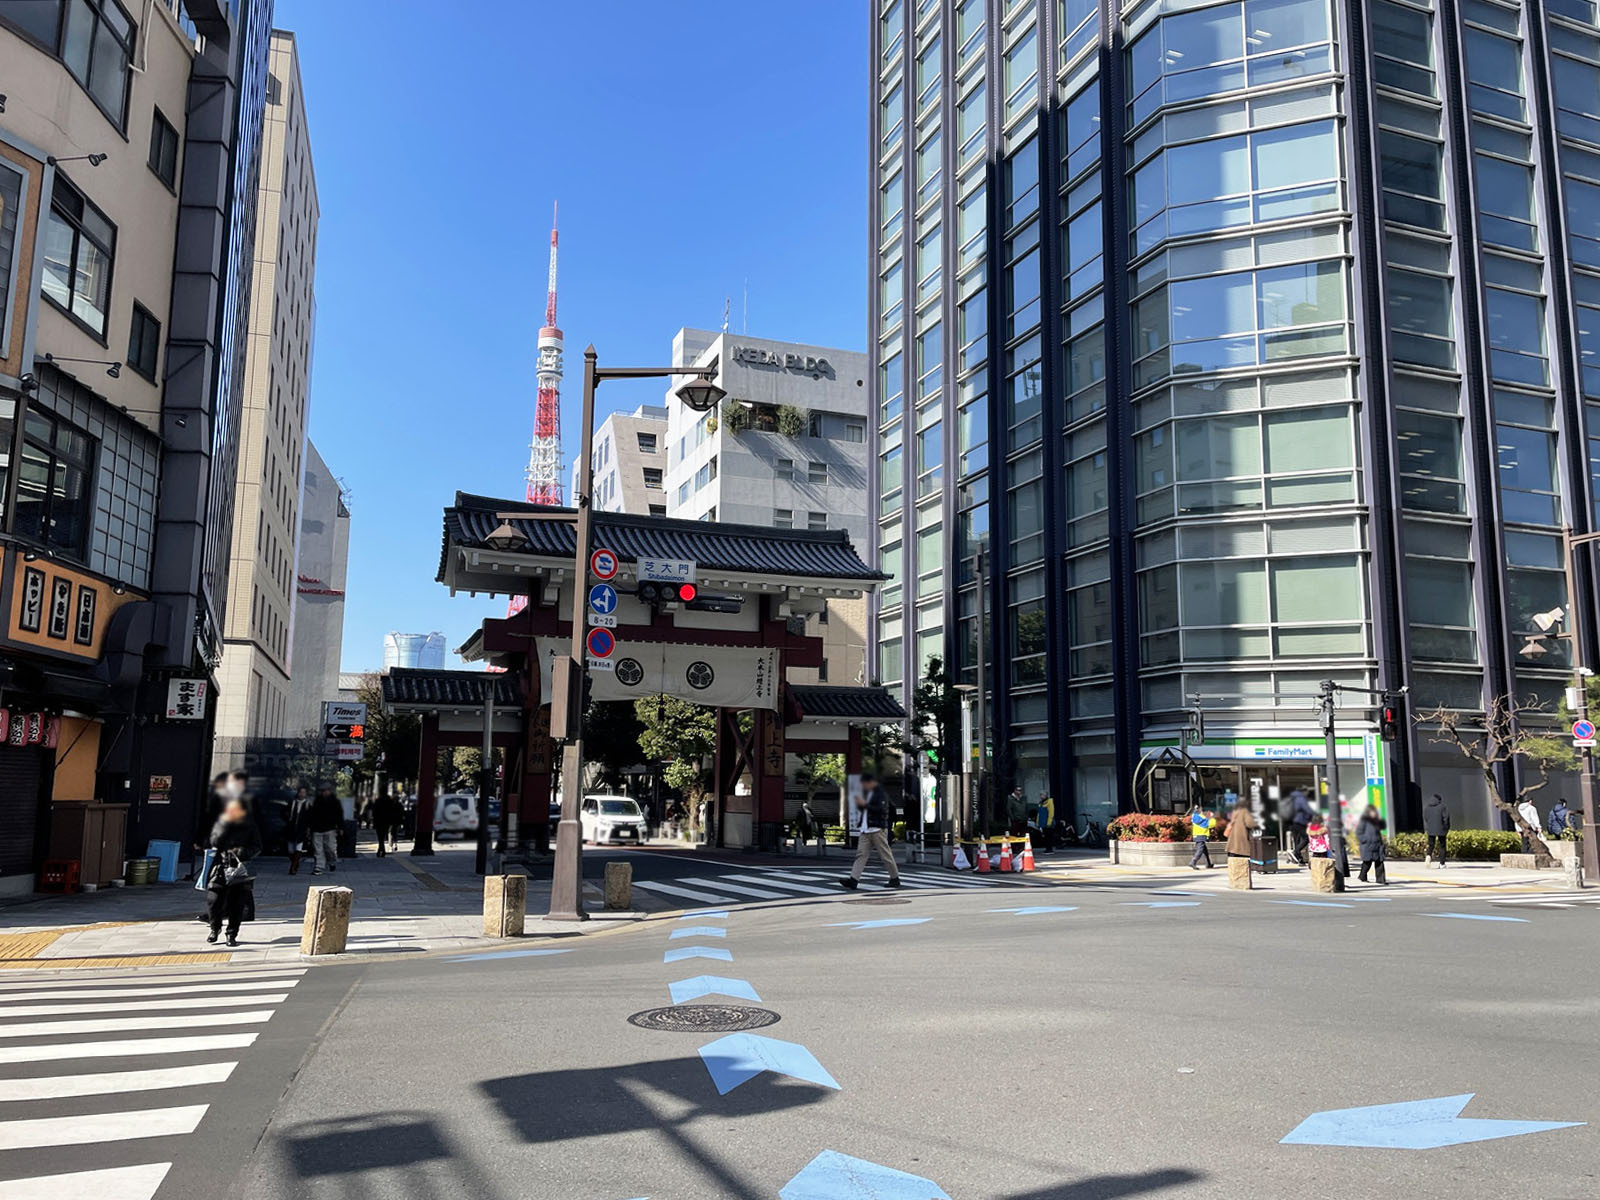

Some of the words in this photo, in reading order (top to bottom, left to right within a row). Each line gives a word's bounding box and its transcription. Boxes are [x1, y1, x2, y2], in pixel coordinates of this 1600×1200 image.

[731, 346, 779, 367] IKEDA
[643, 561, 689, 575] 芝大門
[648, 572, 685, 581] Shibadaimon
[755, 656, 765, 698] 大本山増上寺
[333, 706, 361, 716] Times
[349, 724, 364, 739] 満
[1268, 748, 1313, 756] FamilyMart
[1368, 735, 1376, 776] FamilyMart
